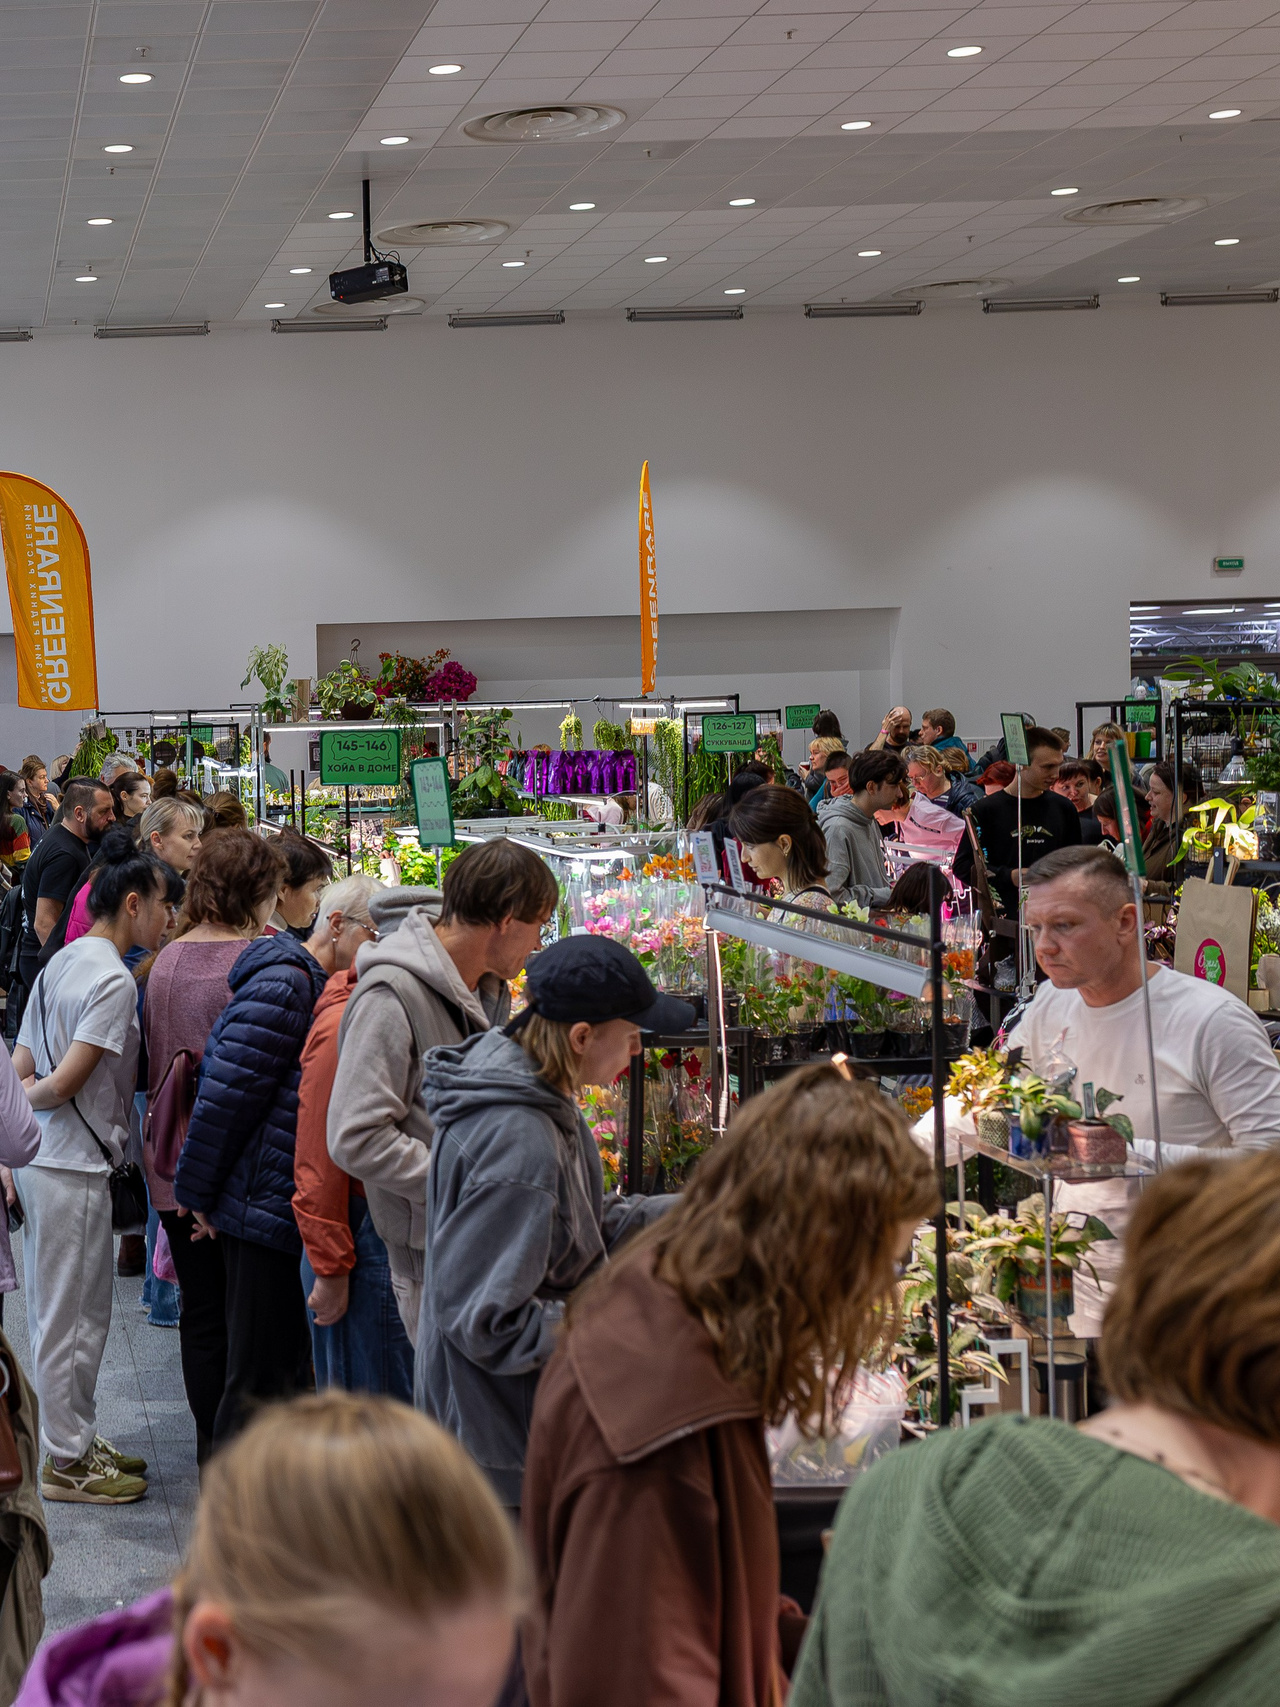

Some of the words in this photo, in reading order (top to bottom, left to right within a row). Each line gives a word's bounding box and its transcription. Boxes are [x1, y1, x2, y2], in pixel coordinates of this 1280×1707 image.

[712, 721, 746, 731] 126-127
[336, 740, 387, 751] 145-146
[327, 762, 355, 773] ХОЙА
[358, 764, 365, 773] В
[367, 764, 397, 774] ДОМЕ
